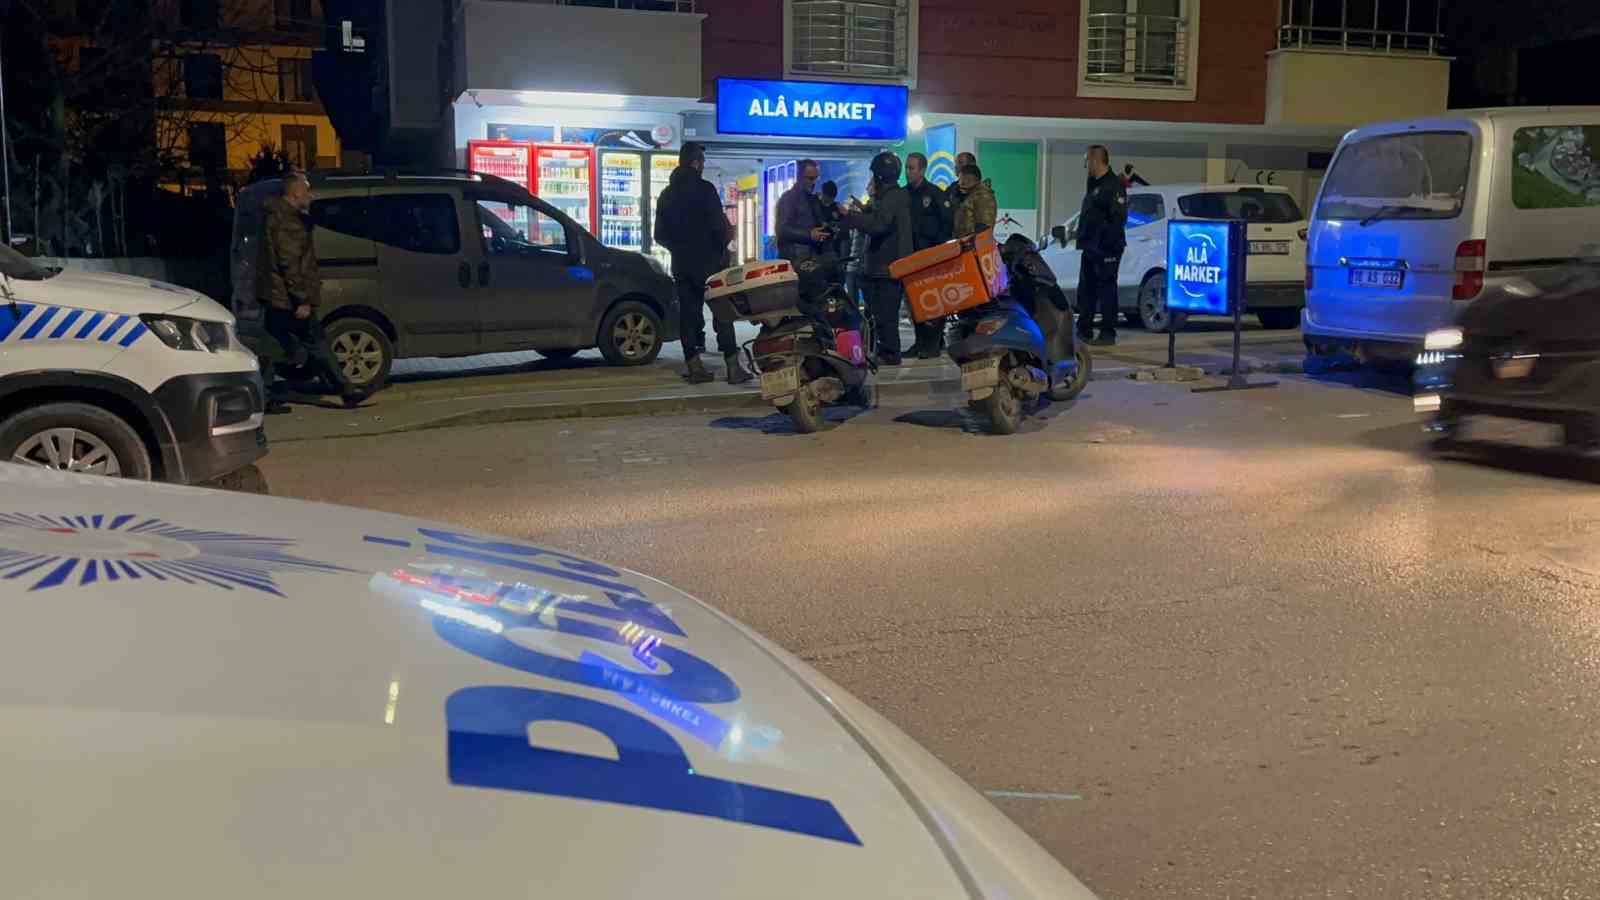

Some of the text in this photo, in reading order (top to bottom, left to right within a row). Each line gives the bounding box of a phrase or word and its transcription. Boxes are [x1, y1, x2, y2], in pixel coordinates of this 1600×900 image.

[749, 95, 875, 121] ALÂ MARKET
[1186, 241, 1208, 264] ALÂ
[1173, 264, 1221, 284] MARKET
